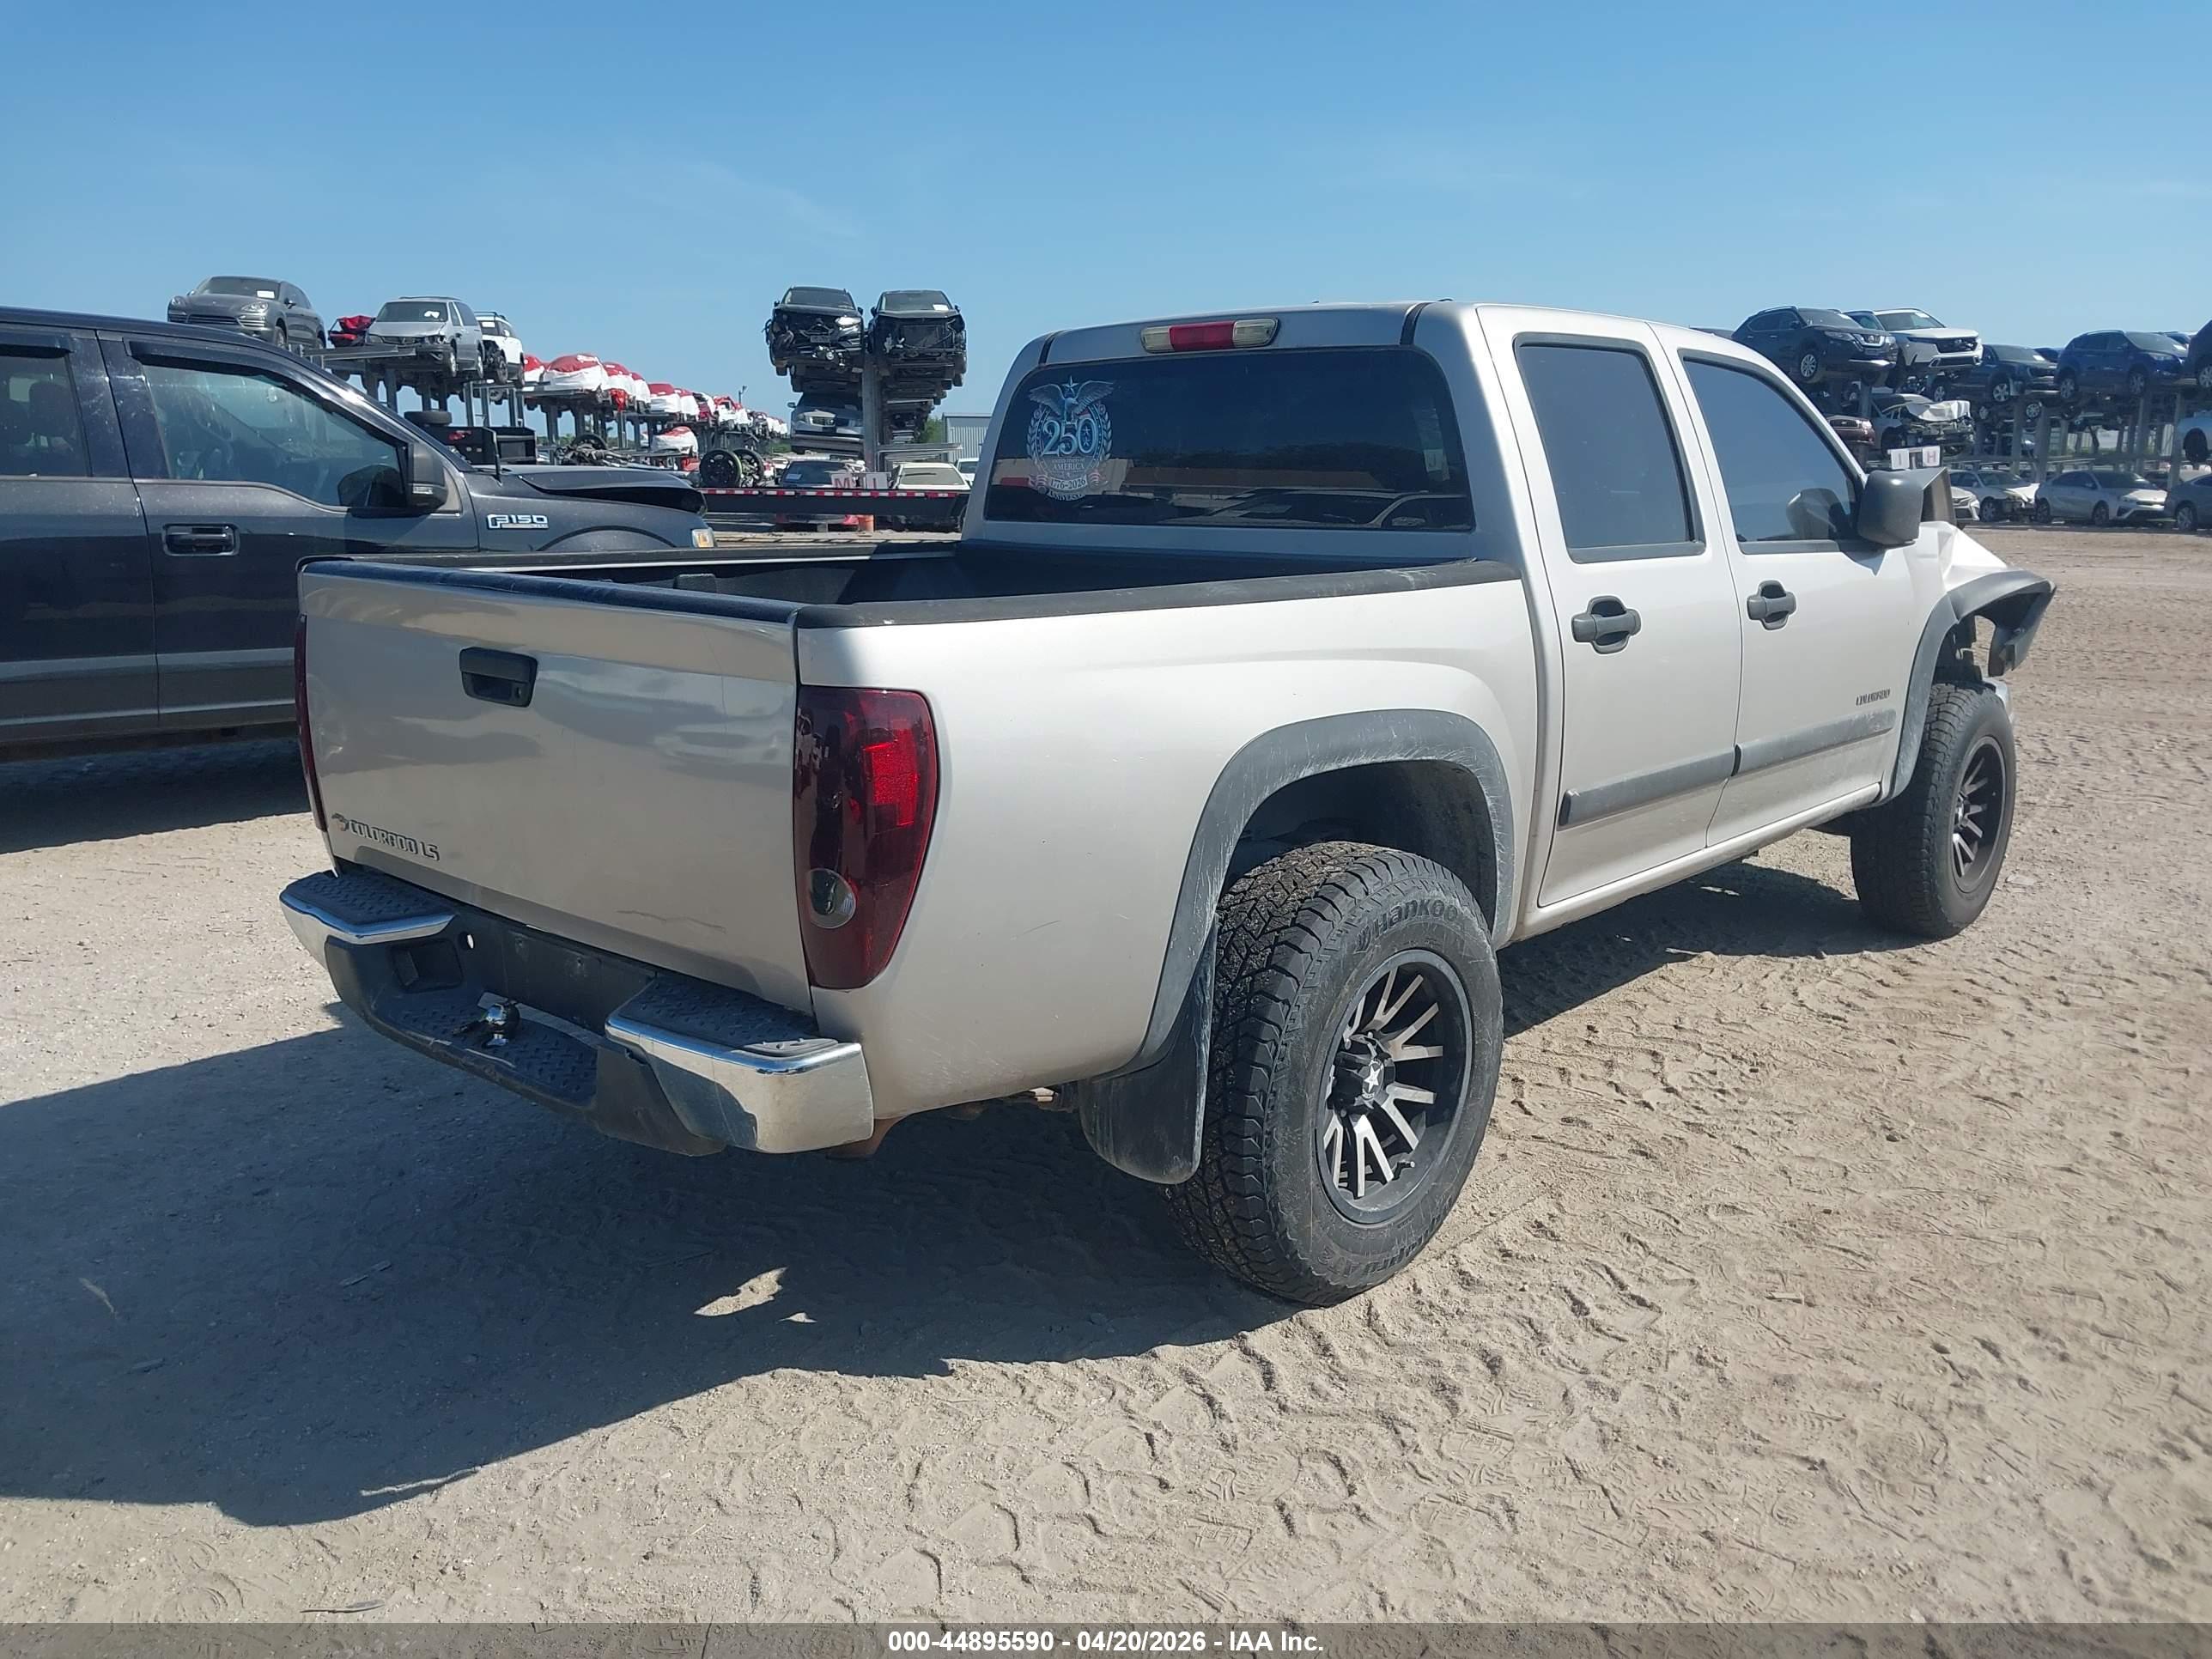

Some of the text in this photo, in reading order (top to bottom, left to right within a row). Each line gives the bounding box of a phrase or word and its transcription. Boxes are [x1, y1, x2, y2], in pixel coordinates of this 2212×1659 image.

[1042, 417, 1097, 456] 250
[1053, 462, 1085, 471] AMERICA
[1926, 450, 1937, 464] H
[1049, 477, 1087, 491] 1776-2026
[349, 819, 441, 861] COLORADO LS
[1373, 899, 1460, 940] Hankoo
